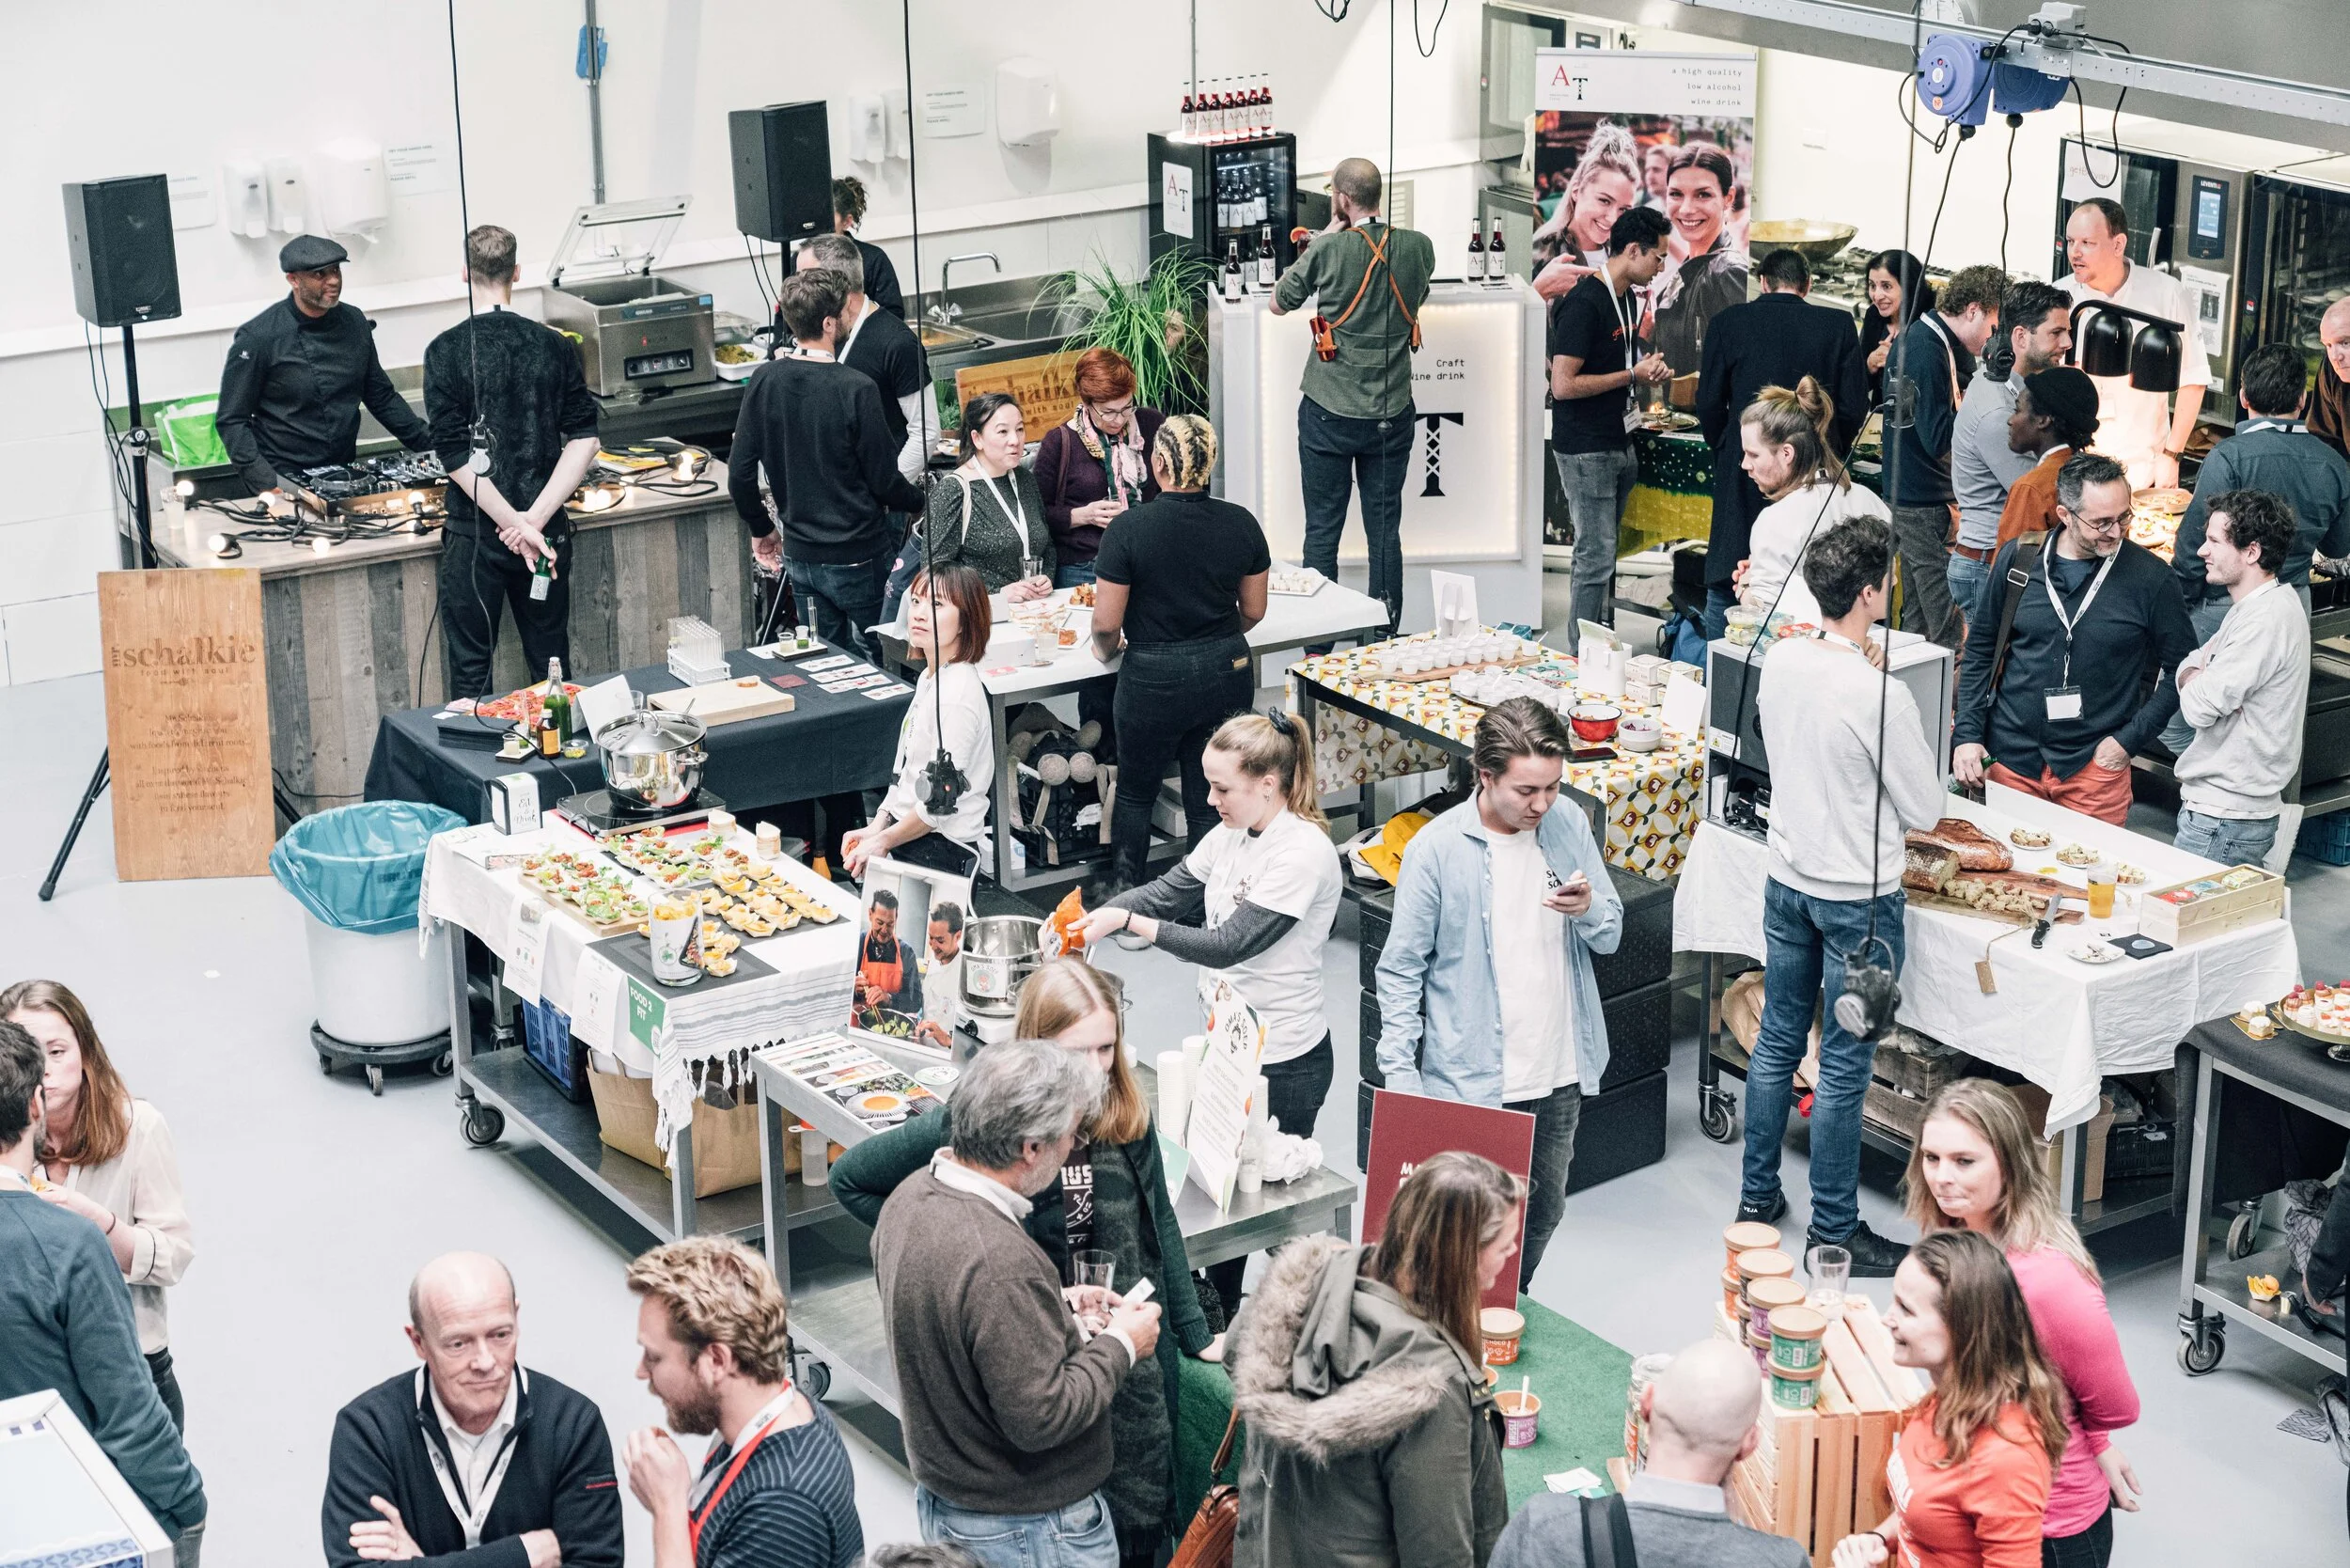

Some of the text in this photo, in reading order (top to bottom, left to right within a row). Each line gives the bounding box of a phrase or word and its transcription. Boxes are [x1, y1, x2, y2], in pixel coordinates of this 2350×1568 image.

[1682, 67, 1702, 76] high
[1706, 69, 1743, 77] quality
[1706, 83, 1742, 91] alcohol
[1690, 98, 1711, 106] wine
[1436, 359, 1465, 368] Craft
[1436, 371, 1465, 380] drink
[1052, 400, 1074, 411] soul
[122, 635, 256, 668] schalkie
[141, 668, 166, 677] food
[630, 985, 653, 1012] FOOD 2
[636, 1007, 648, 1022] FIT
[1743, 1205, 1759, 1214] VEJA
